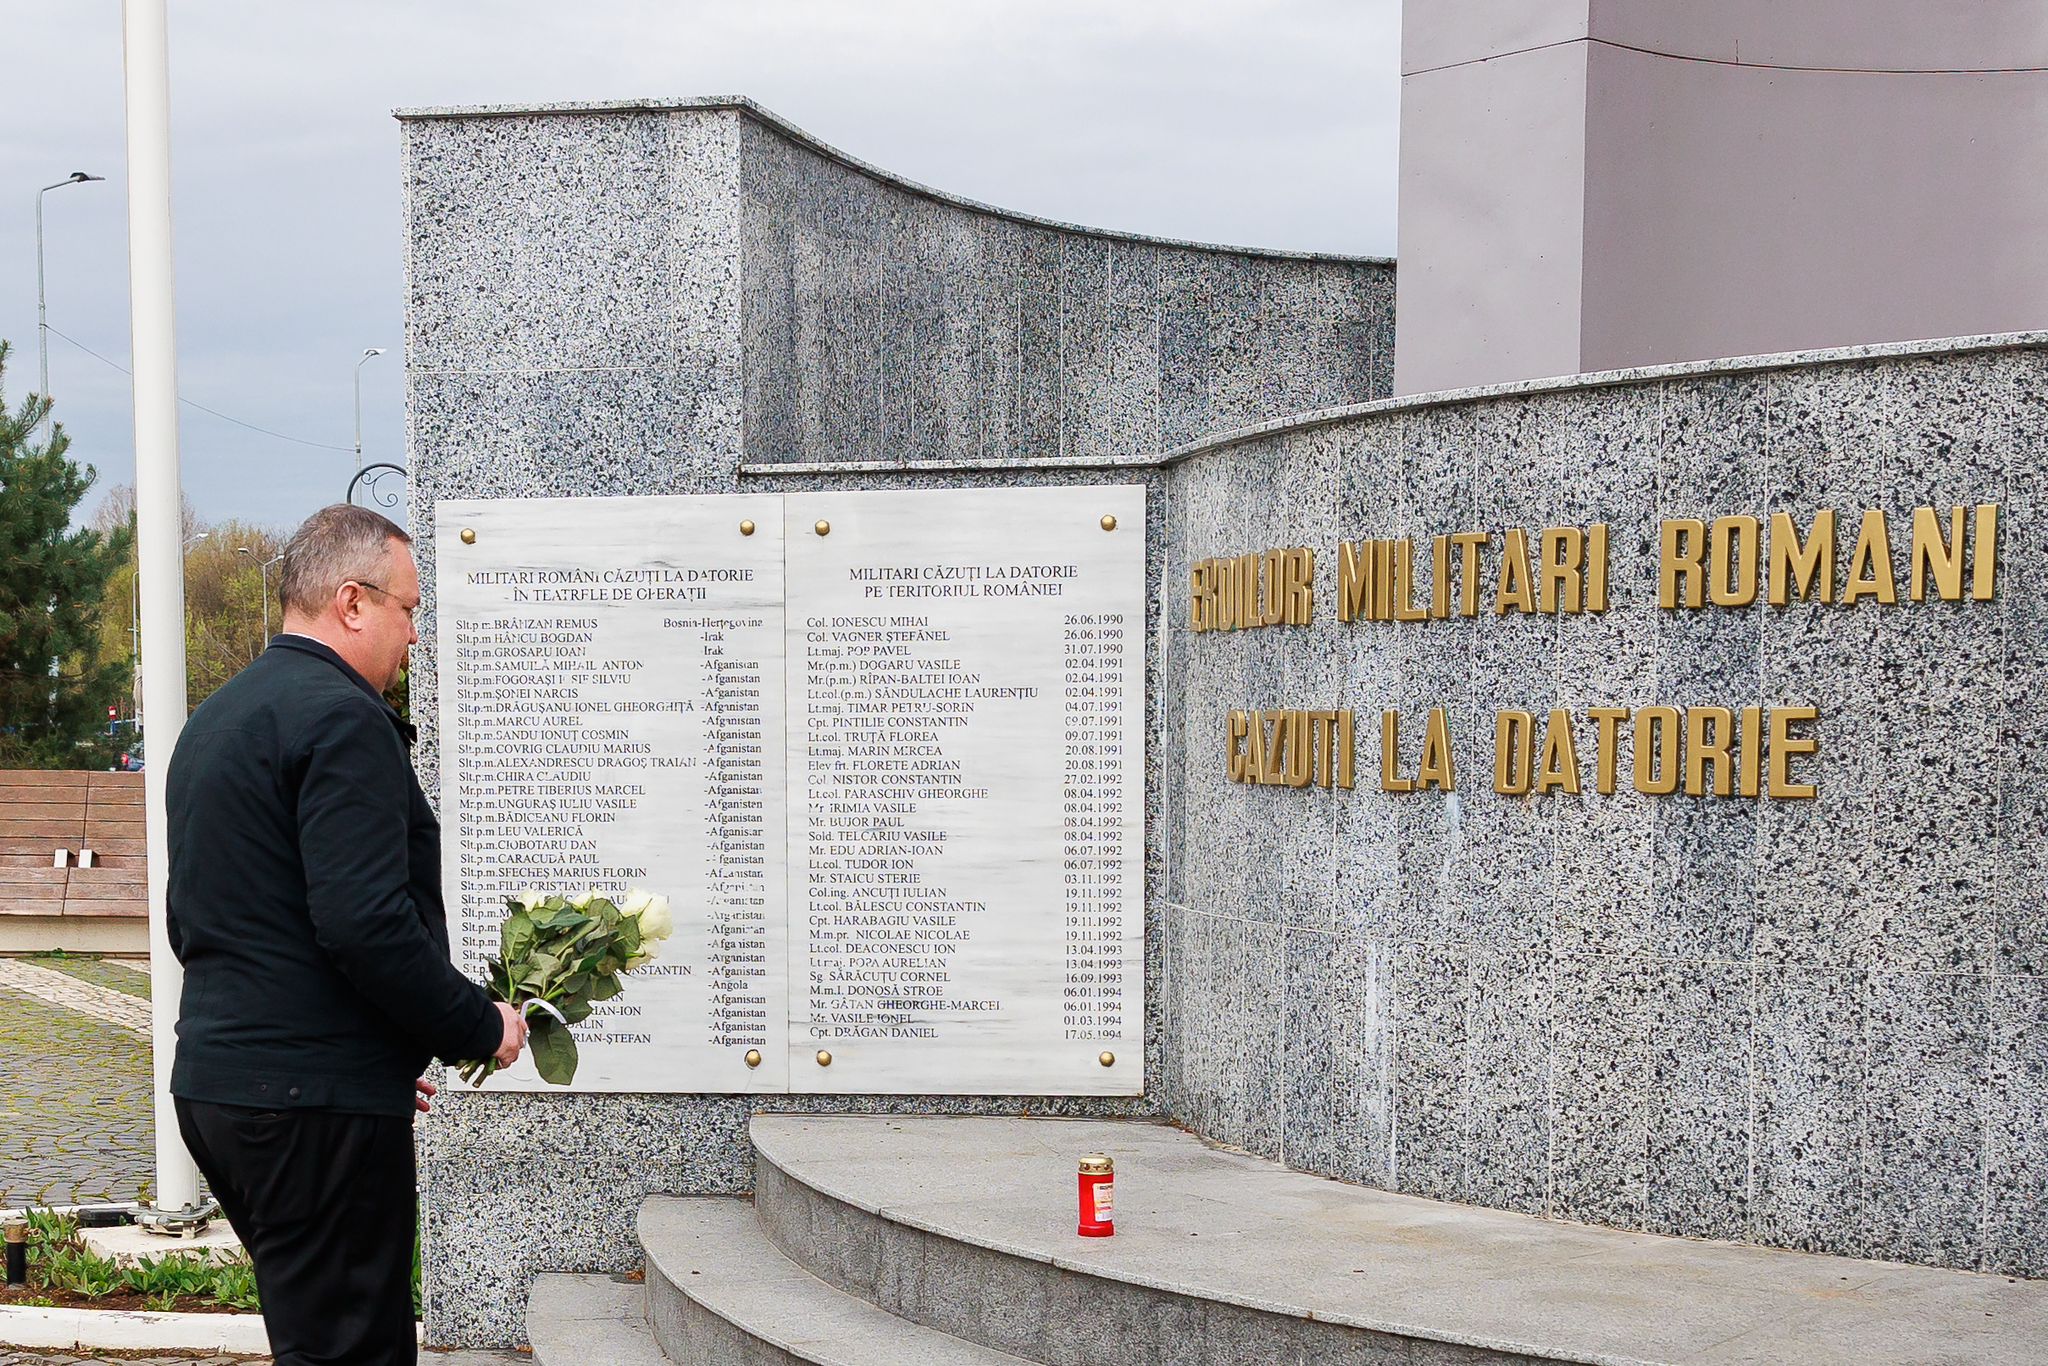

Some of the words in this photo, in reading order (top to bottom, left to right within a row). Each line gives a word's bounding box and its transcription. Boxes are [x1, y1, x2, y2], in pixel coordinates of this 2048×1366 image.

[850, 568, 918, 582] MILITARI
[986, 567, 1007, 579] LA
[1010, 564, 1078, 579] DATORIE
[1190, 547, 1313, 632] EROILOR
[1338, 523, 1609, 622] MILITARI
[1660, 504, 2002, 609] ROMANI
[467, 571, 535, 585] MILITARI
[665, 569, 686, 583] LA
[613, 587, 632, 600] DE
[865, 584, 883, 598] PE
[886, 583, 978, 598] TERITORIUL
[983, 580, 1062, 596] ROMÂNIEI
[556, 617, 598, 630] REMUS
[807, 617, 828, 629] Col.
[832, 617, 886, 628] IONESCU
[890, 617, 928, 628] MIHAI
[1064, 614, 1123, 627] 26.06.1990
[541, 631, 592, 644] BOGDAN
[807, 631, 828, 643] Col.
[832, 630, 882, 643] VAGNER
[1064, 628, 1123, 642] 26.06.1990
[556, 645, 586, 658] IOAN
[847, 645, 870, 657] POP
[873, 644, 912, 657] PAVEL
[1065, 643, 1123, 656] 31.07.1990
[808, 659, 856, 673] Mr.(p.m.)
[860, 658, 914, 671] DOGARU
[917, 659, 961, 671] VASILE
[1065, 657, 1123, 671] 02.04.1991
[808, 673, 856, 687] Mr.(p.m.)
[949, 672, 980, 685] IOAN
[1065, 672, 1123, 685] 02.04.1991
[533, 687, 578, 700] NARCIS
[875, 684, 960, 700] SĂNDULACHE
[1065, 686, 1123, 699] 02.04.1991
[575, 700, 611, 714] IONEL
[847, 701, 887, 714] TIMAR
[1065, 700, 1123, 714] 04.07.1991
[543, 714, 583, 728] AUREL
[808, 716, 829, 729] Cpt.
[833, 716, 884, 728] PINTILIE
[888, 715, 968, 728] CONSTANTIN
[581, 730, 629, 741] COSMIN
[808, 731, 841, 743] Lt.col.
[890, 730, 938, 743] FLOREA
[1065, 730, 1123, 742] 09.07.1991
[546, 742, 601, 755] CLAUDIU
[604, 742, 651, 755] MARIUS
[848, 744, 890, 757] MARIN
[893, 744, 942, 757] MIRCEA
[1065, 744, 1123, 756] 20.08.1991
[1227, 708, 1354, 788] CAZUTI
[1381, 707, 1455, 791] LA
[1494, 706, 1818, 798] DATORIE
[651, 757, 696, 767] TRAIAN
[852, 758, 908, 771] FLORETE
[911, 758, 960, 771] ADRIAN
[1065, 758, 1123, 771] 20.08.1991
[833, 773, 878, 786] NISTOR
[882, 772, 962, 786] CONSTANTIN
[1064, 773, 1122, 786] 27.02.1992
[538, 784, 591, 797] TIBERIUS
[595, 785, 646, 797] MARCEL
[844, 787, 915, 800] PARASCHIV
[918, 787, 988, 799] GHEORGHE
[1064, 787, 1122, 800] 08.04.1992
[559, 797, 591, 810] IULIU
[594, 797, 637, 810] VASILE
[874, 802, 916, 814] VASILE
[1064, 801, 1122, 814] 08.04.1992
[572, 811, 615, 824] FLORIN
[829, 816, 870, 828] BUJOR
[873, 816, 905, 828] PAUL
[1063, 816, 1123, 829] 08.04.1992
[809, 830, 834, 843] Sold.
[837, 830, 900, 842] TELCARIU
[904, 831, 947, 842] VASILE
[1064, 830, 1122, 843] 08.04.1992
[569, 839, 597, 851] DAN
[809, 844, 827, 856] Mr.
[830, 844, 855, 856] EDU
[858, 844, 943, 856] ADRIAN-IOAN
[1064, 844, 1122, 857] 06.07.1992
[569, 852, 600, 865] PAUL
[809, 858, 842, 871] Lt.col.
[845, 858, 889, 871] TUDOR
[892, 858, 913, 870] ION
[1064, 859, 1123, 872] 06.07.1992
[550, 866, 599, 879] MARIUS
[603, 868, 646, 879] FLORIN
[809, 873, 827, 885] Mr.
[830, 872, 874, 885] STAICU
[878, 872, 921, 885] STERIE
[1065, 872, 1122, 886] 03.11.1992
[903, 887, 946, 899] IULIAN
[1066, 887, 1122, 900] 19.11.1992
[809, 901, 842, 913] Lt.col.
[845, 899, 902, 913] BĂLESCU
[905, 900, 986, 913] CONSTANTIN
[1066, 901, 1122, 914] 19.11.1992
[809, 915, 830, 929] Cpt.
[833, 915, 910, 927] HARABAGIU
[913, 915, 956, 927] VASILE
[1066, 915, 1122, 928] 19.11.1992
[856, 929, 911, 941] NICOLAE
[914, 929, 970, 941] NICOLAE
[1066, 929, 1123, 942] 19.11.1992
[808, 943, 842, 955] Lt.col.
[845, 943, 929, 955] DEACONESCU
[934, 943, 956, 955] ION
[1066, 943, 1122, 956] 13.04.1993
[882, 957, 946, 969] AURELIAN
[1066, 958, 1123, 971] 13.04.1993
[900, 971, 951, 983] CORNEL
[1064, 972, 1122, 984] 16.09.1993
[902, 985, 943, 997] STROE
[1064, 986, 1122, 999] 06.01.1994
[810, 999, 827, 1012] Mr.
[1064, 1001, 1121, 1013] 06.01.1994
[831, 1013, 873, 1025] VASILE
[1064, 1015, 1122, 1027] 01.03.1994
[810, 1026, 831, 1040] Cpt.
[834, 1024, 887, 1037] DRĂGAN
[891, 1026, 938, 1038] DANIEL
[1065, 1028, 1121, 1041] 17.05.1994
